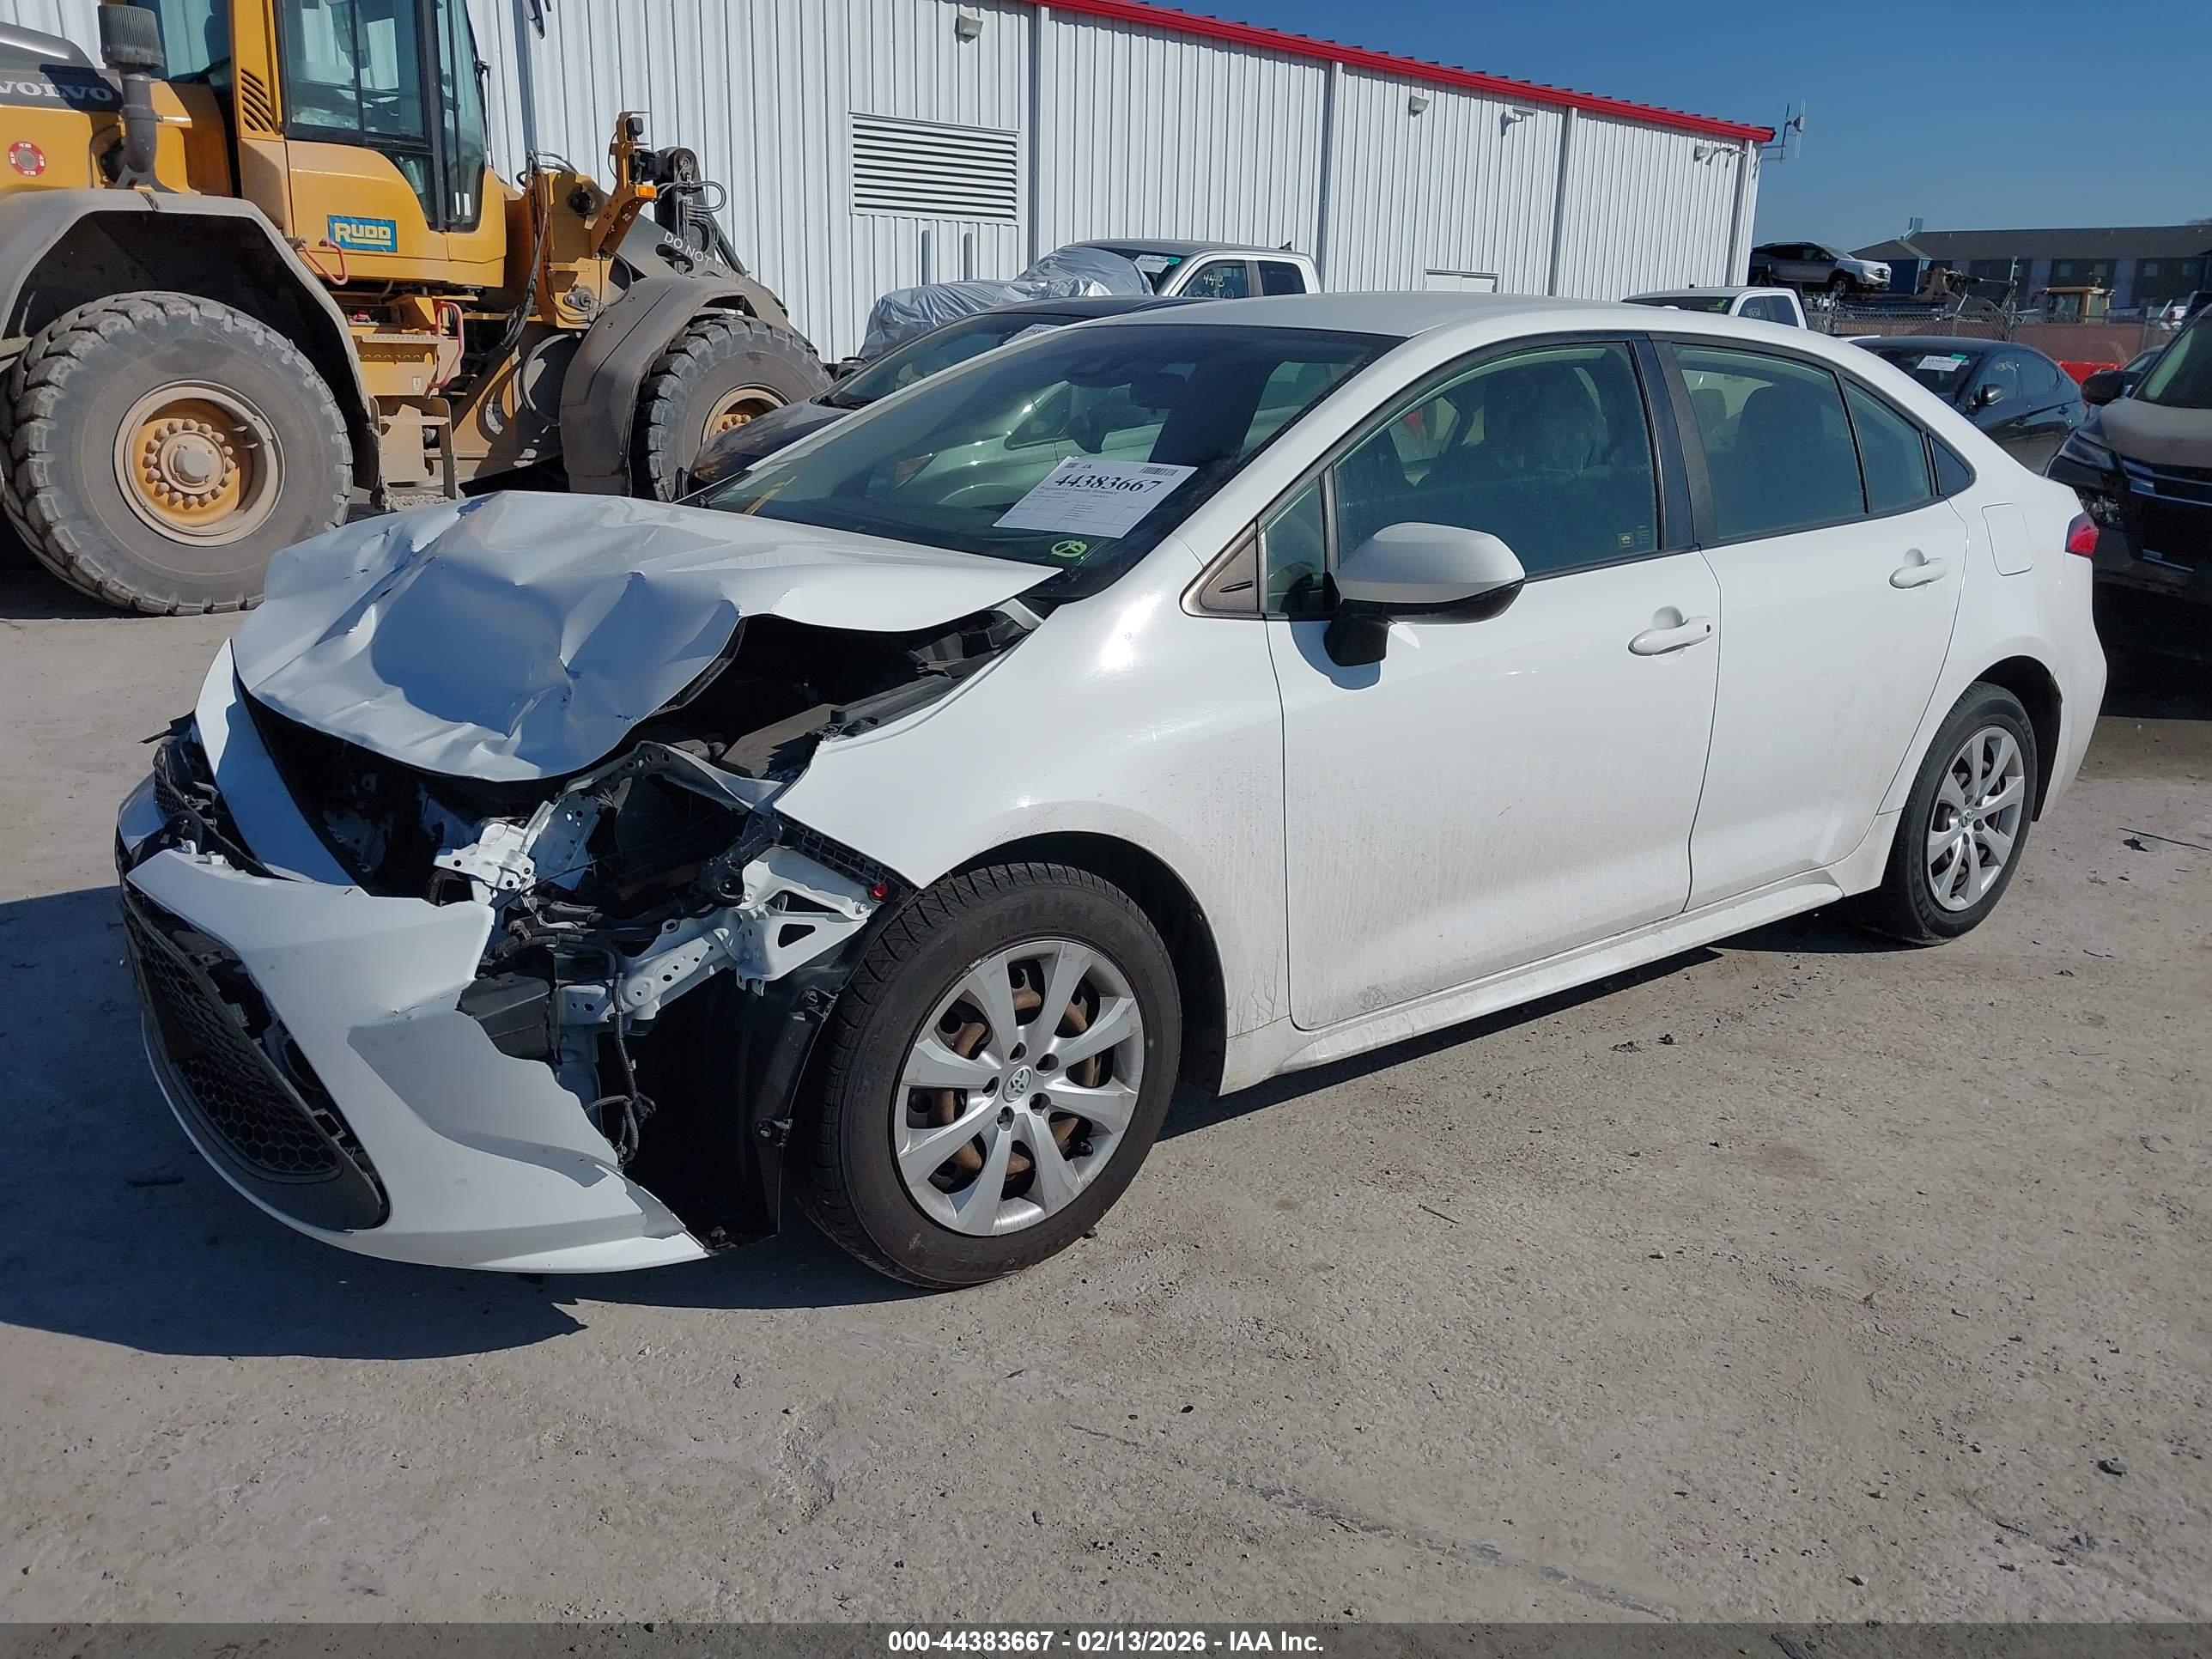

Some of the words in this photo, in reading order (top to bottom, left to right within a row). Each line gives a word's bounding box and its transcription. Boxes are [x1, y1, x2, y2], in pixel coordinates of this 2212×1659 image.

[0, 80, 113, 101] VOLVO
[334, 222, 392, 243] RUDD
[664, 232, 684, 249] DO
[684, 244, 713, 267] NOT
[1055, 473, 1164, 494] 44383667
